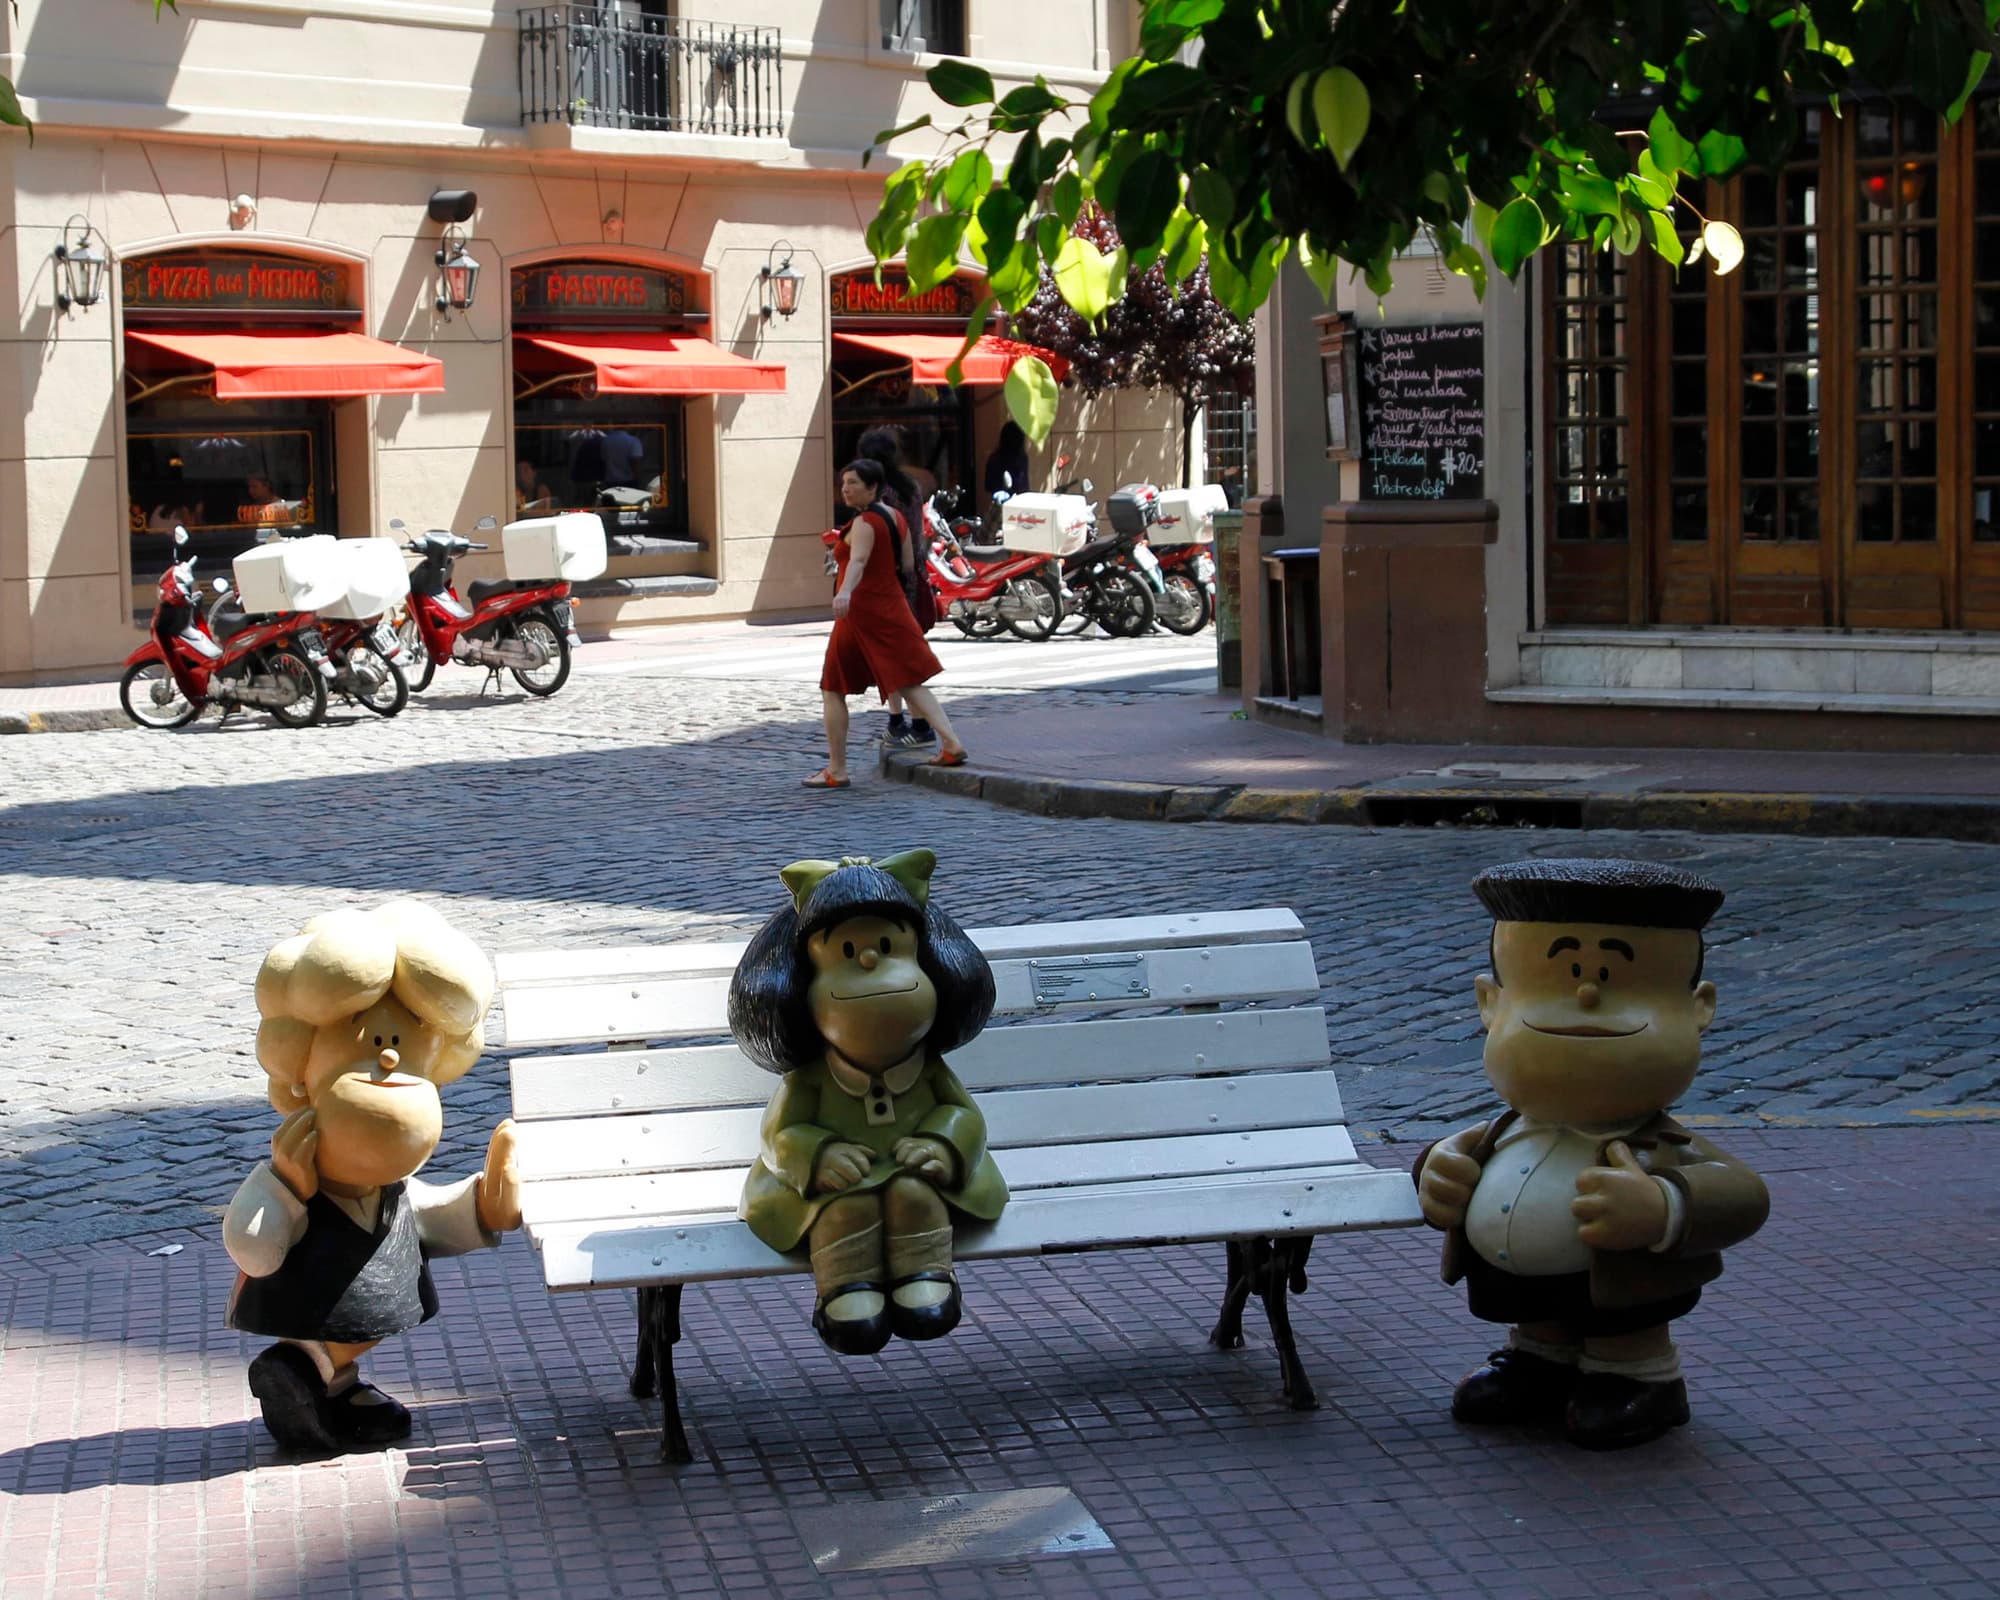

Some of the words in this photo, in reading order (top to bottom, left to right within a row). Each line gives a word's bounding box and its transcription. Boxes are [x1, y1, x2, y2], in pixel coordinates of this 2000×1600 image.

[148, 264, 211, 299] PIZZA
[248, 264, 319, 299] PIEDRA
[547, 270, 648, 305] PASTAS
